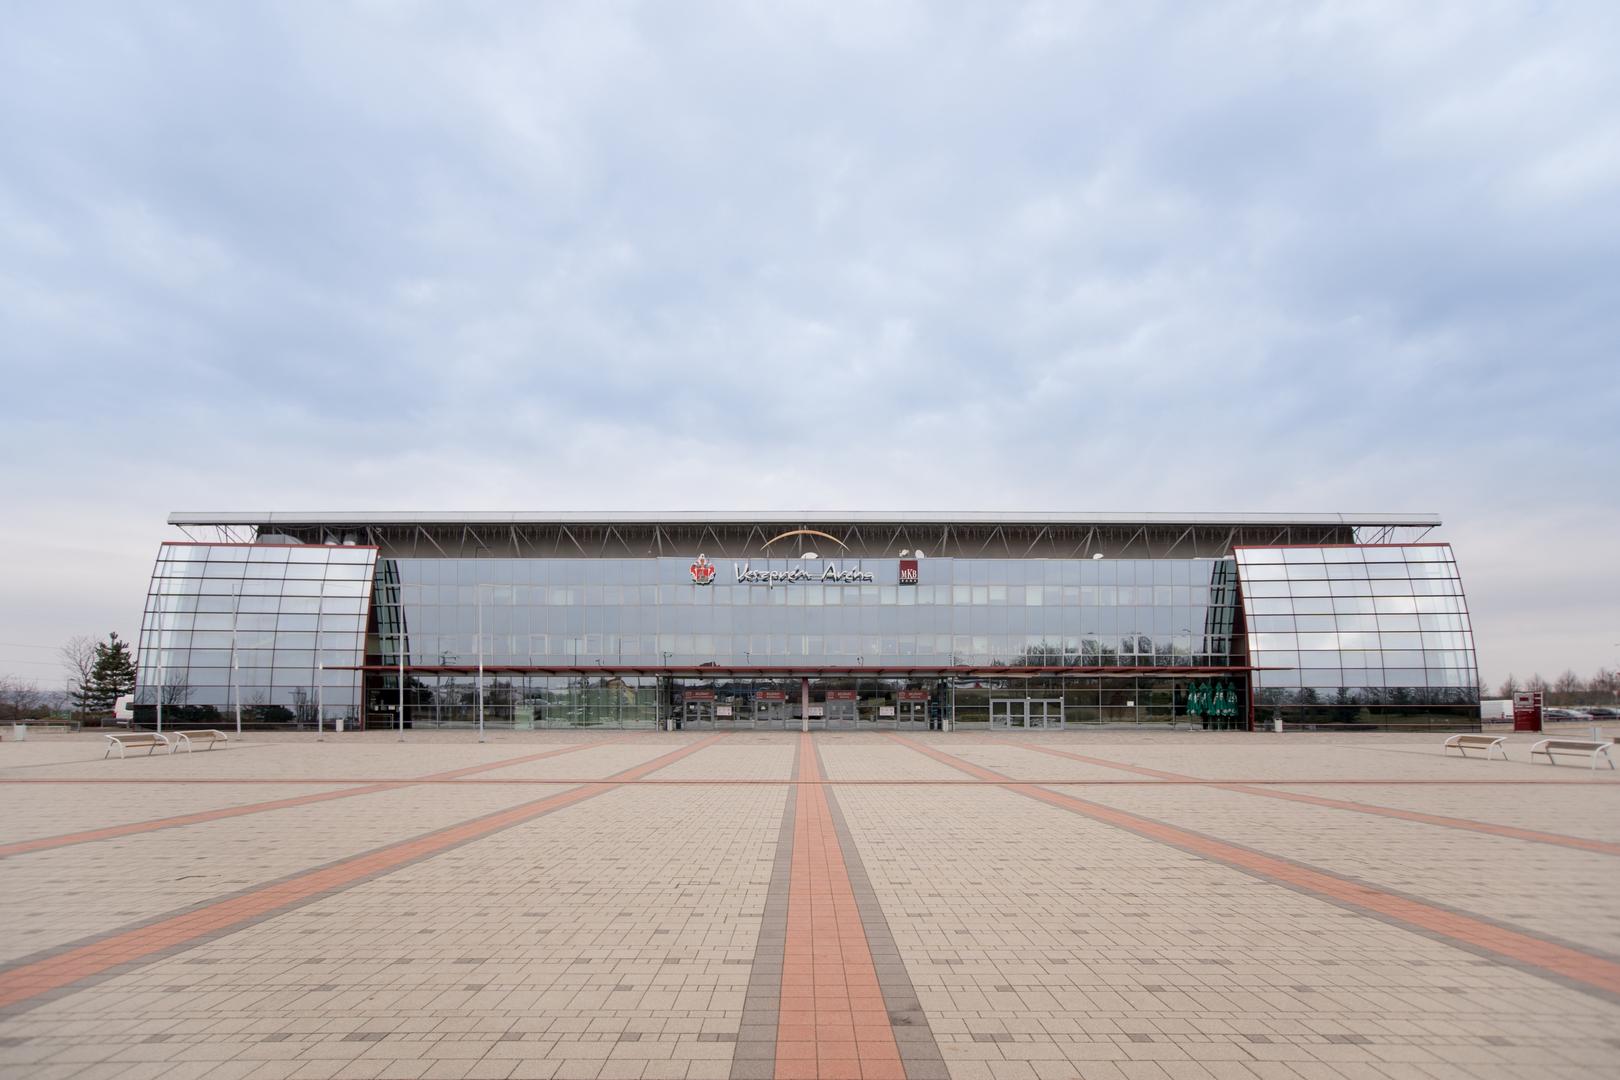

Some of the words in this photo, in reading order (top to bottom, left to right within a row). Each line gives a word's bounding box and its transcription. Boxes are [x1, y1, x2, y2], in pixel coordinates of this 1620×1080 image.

[734, 562, 811, 589] Veszprém
[821, 561, 875, 583] Aréna
[901, 568, 917, 579] MKB
